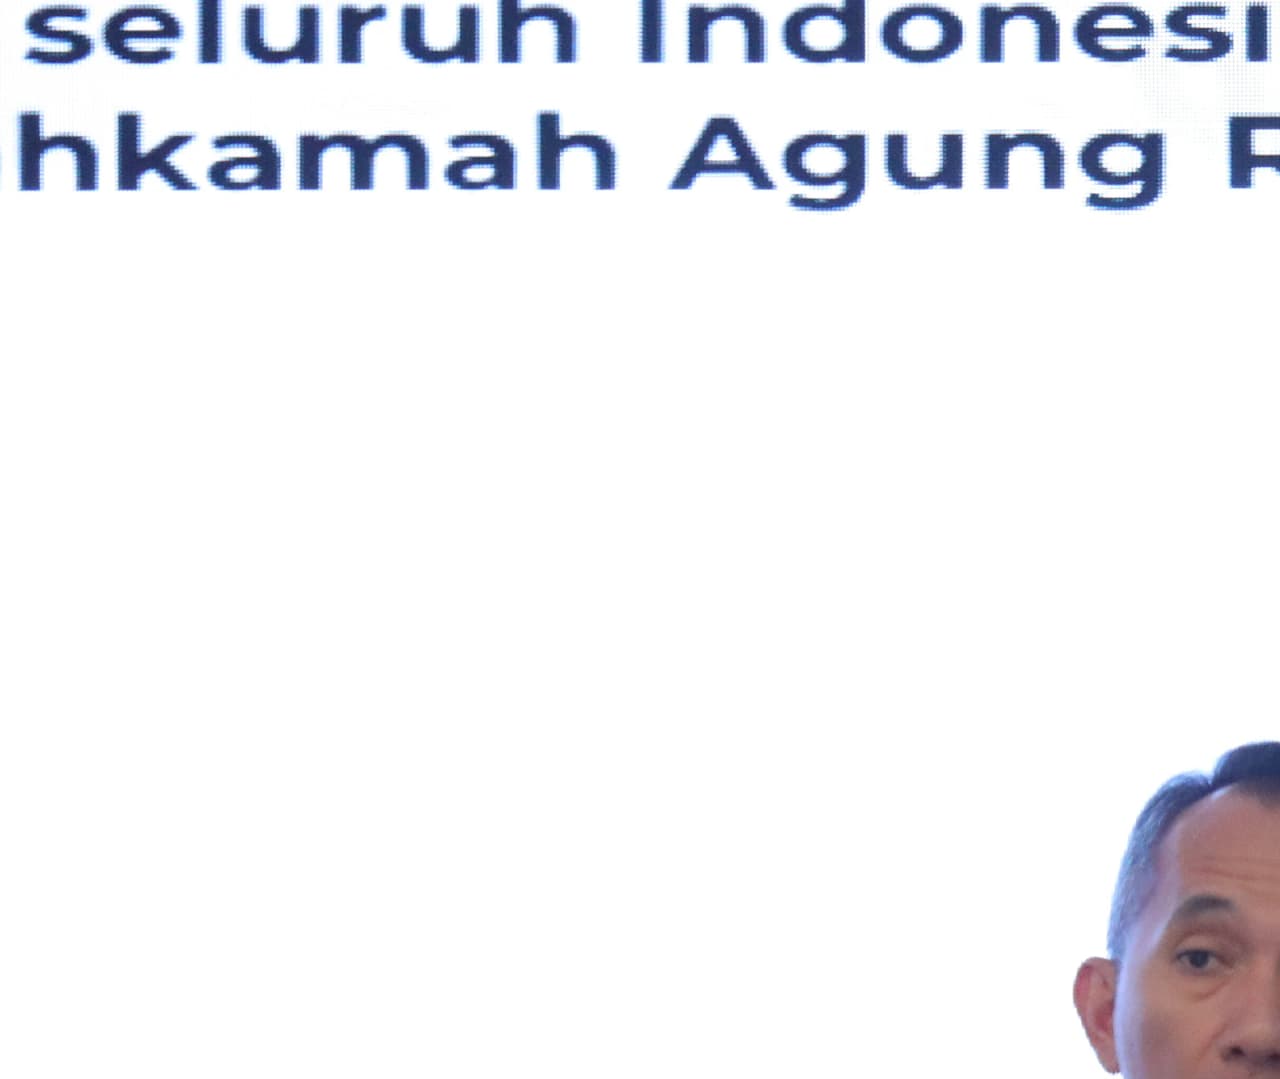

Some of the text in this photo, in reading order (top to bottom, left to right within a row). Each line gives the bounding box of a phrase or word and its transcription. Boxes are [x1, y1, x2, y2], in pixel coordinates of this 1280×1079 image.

[23, 0, 578, 65] seluruh
[0, 110, 617, 192] hkamah
[669, 116, 1165, 212] Agung
